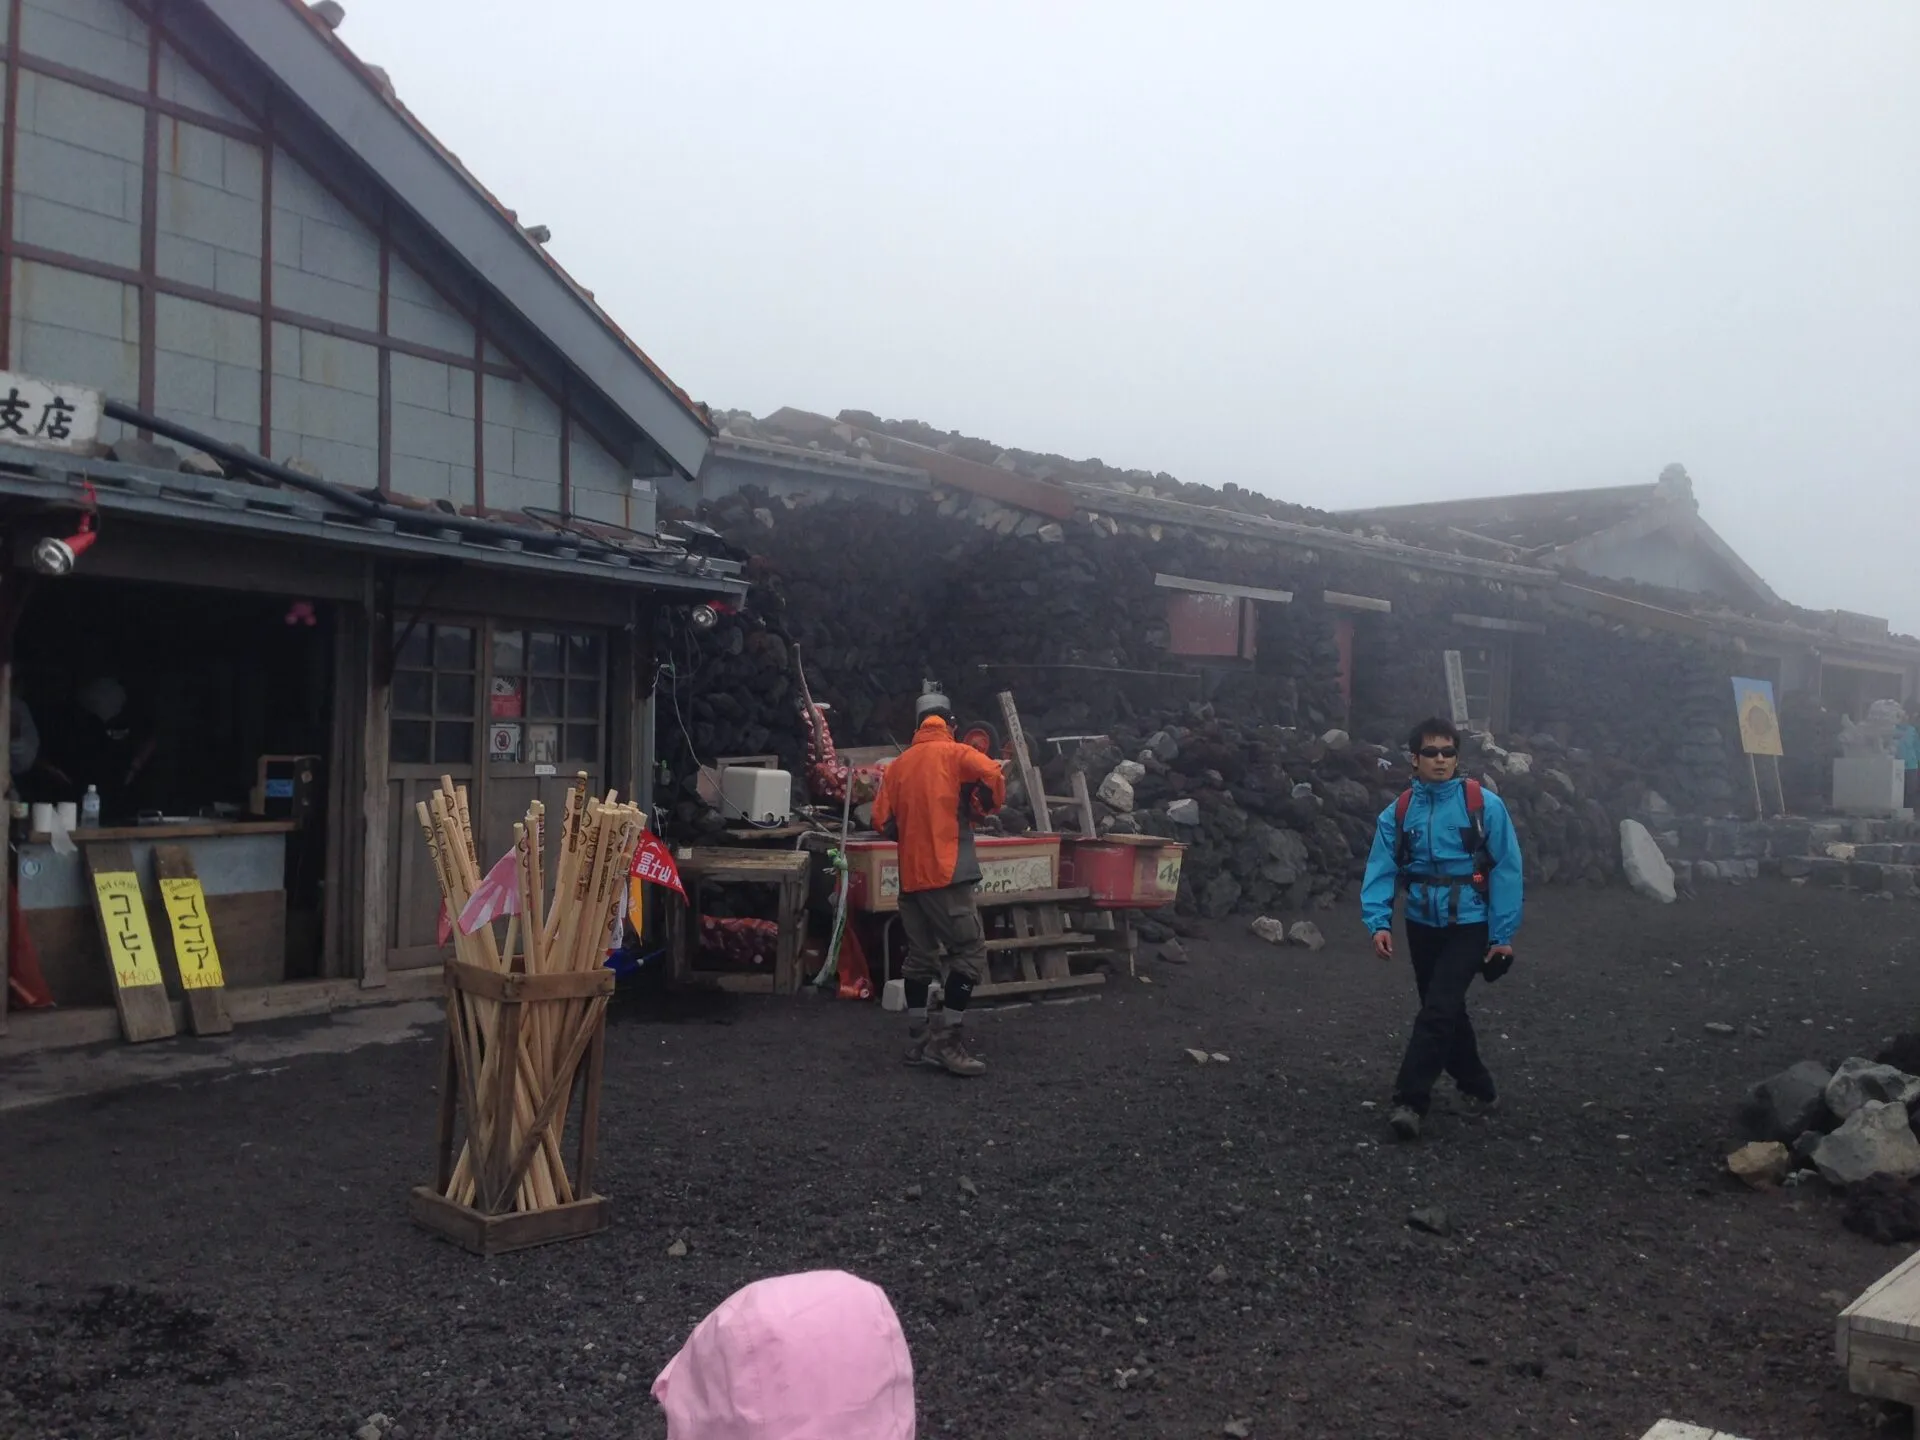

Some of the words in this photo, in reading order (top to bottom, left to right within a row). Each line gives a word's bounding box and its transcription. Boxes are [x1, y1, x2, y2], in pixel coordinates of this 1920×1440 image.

[0, 387, 75, 440] 支店
[109, 894, 141, 968] コーヒー
[173, 894, 209, 970] ココア
